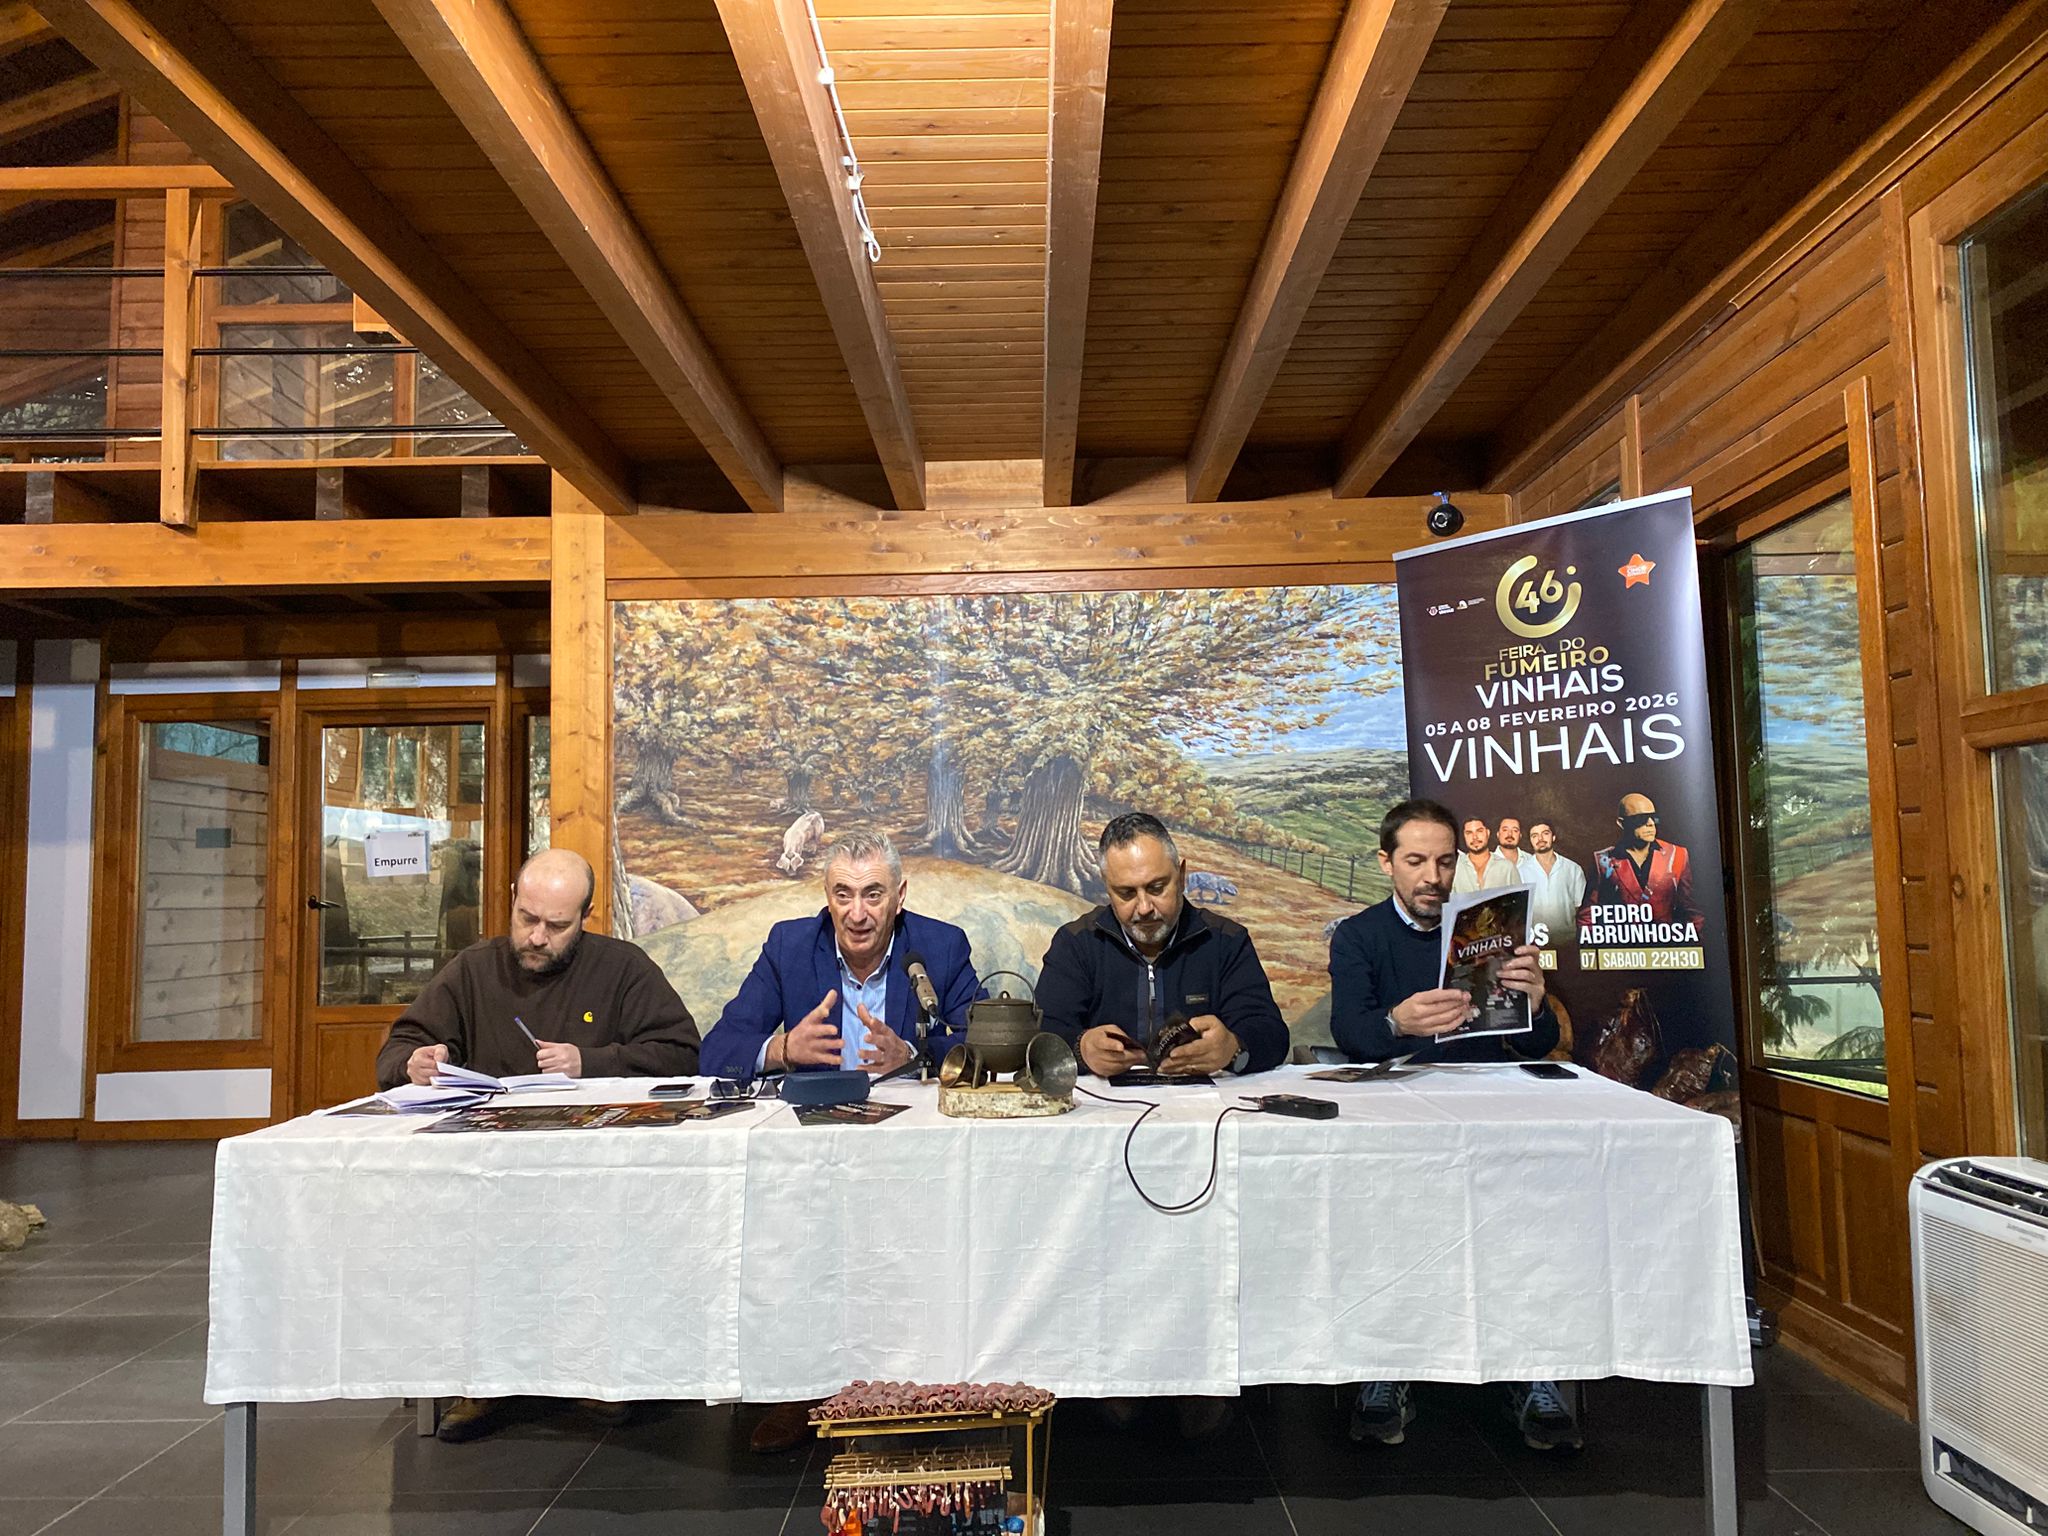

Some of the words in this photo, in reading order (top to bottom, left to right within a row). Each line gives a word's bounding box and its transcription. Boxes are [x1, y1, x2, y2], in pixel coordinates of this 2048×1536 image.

[1515, 569, 1564, 614] 46
[1499, 643, 1547, 661] FEIRA
[1559, 637, 1585, 652] DO
[1484, 646, 1609, 681] FUMEIRO
[1475, 663, 1625, 710] VINHAIS
[1425, 721, 1447, 737] 05
[1450, 721, 1464, 734] A
[1467, 716, 1491, 732] 08
[1500, 700, 1616, 728] FEVEREIRO
[1625, 692, 1679, 712] 2026
[1423, 713, 1686, 783] VINHAIS
[374, 857, 418, 868] Empurre
[1591, 904, 1653, 925] PEDRO
[1580, 922, 1699, 945] ABRUNHOSA
[1458, 935, 1512, 958] VINHAIS
[1581, 952, 1596, 968] 07
[1603, 951, 1646, 968] SABADO
[1651, 950, 1700, 968] 22H30
